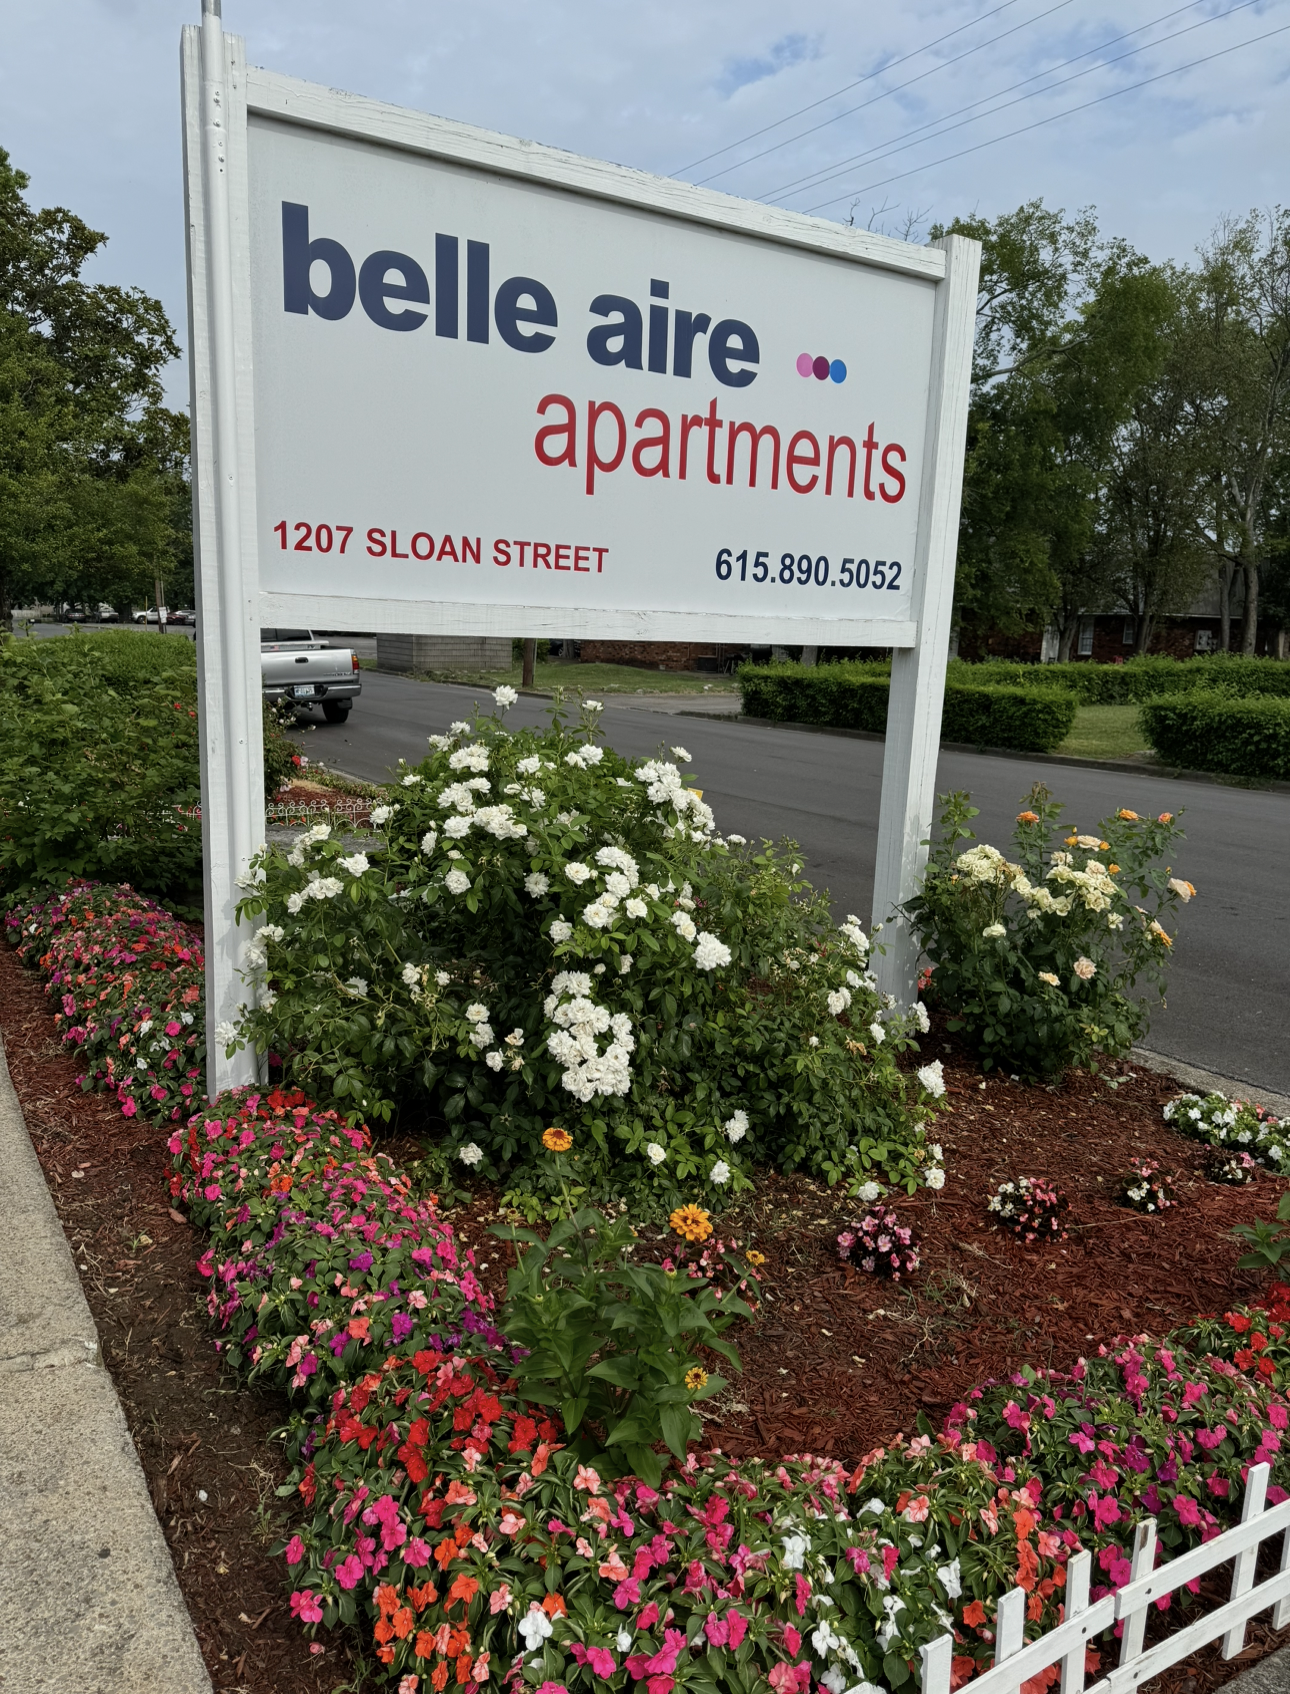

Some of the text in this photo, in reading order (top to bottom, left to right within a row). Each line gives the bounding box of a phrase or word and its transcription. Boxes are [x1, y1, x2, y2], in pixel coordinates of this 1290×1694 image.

[281, 201, 760, 388] belle aire
[534, 394, 907, 504] apartments
[273, 520, 610, 573] 1207 SLOAN STREET
[715, 549, 902, 590] 615.890.5052
